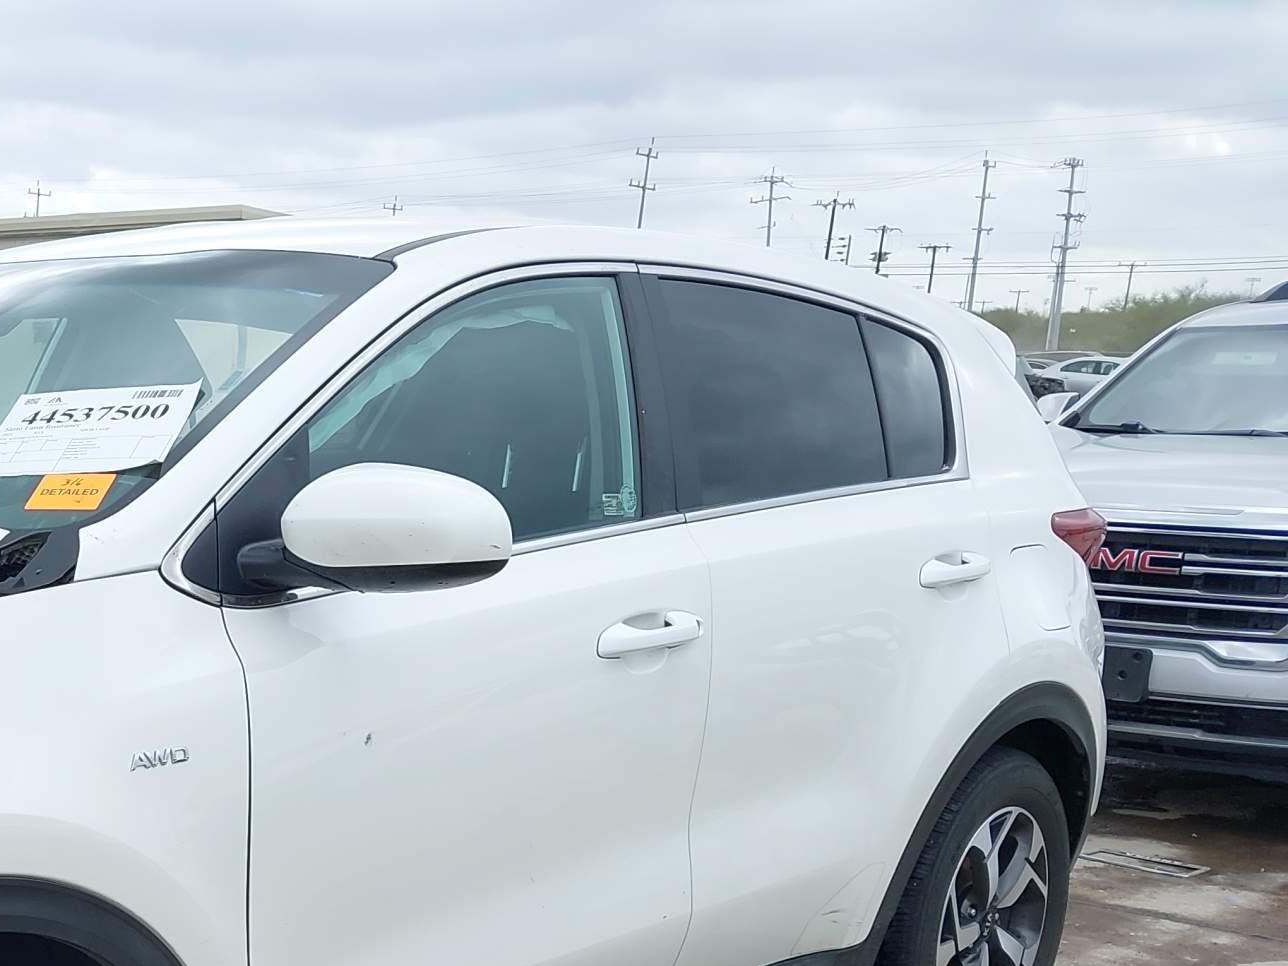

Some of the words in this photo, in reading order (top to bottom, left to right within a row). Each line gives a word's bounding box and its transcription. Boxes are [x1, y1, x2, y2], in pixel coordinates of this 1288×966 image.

[21, 403, 170, 426] 44537500
[40, 488, 99, 496] DETAILED
[1091, 547, 1183, 575] MC
[129, 748, 190, 772] AWD
